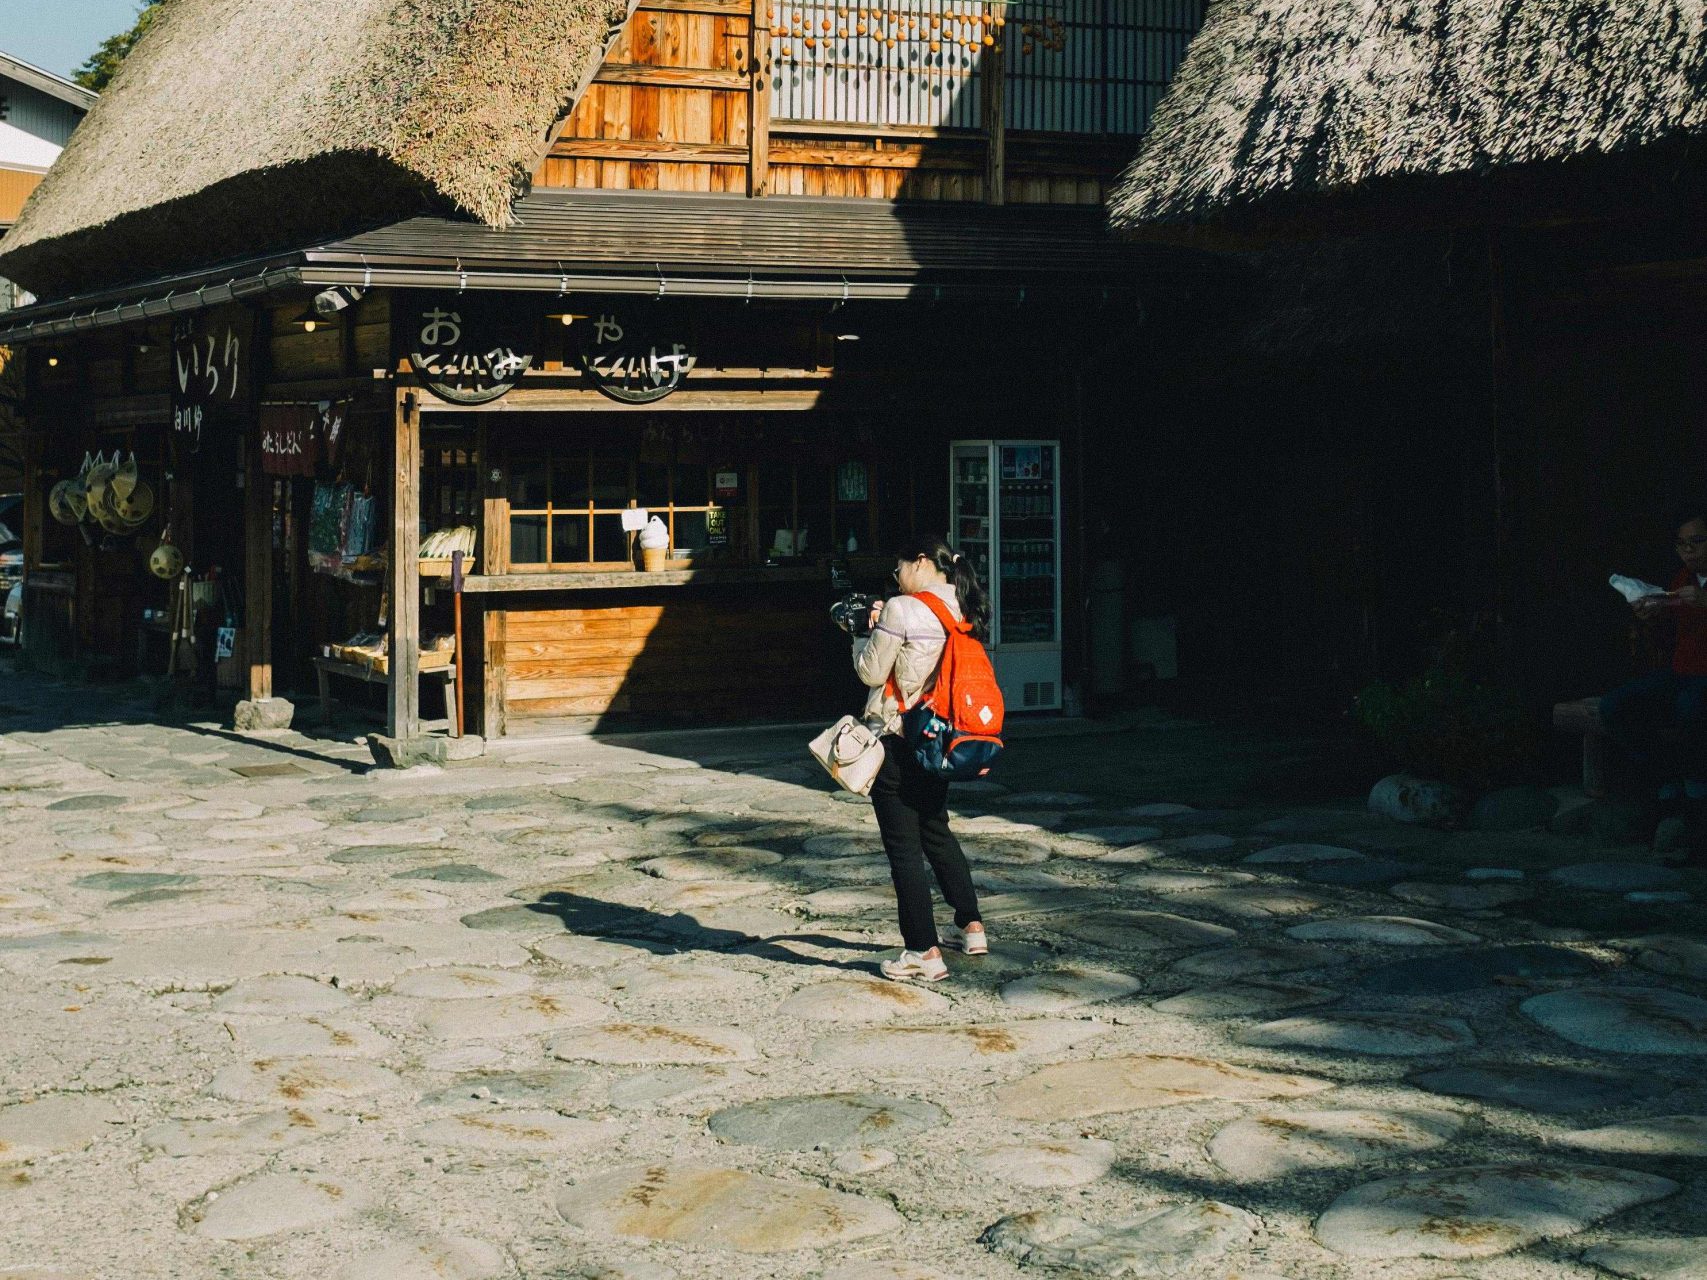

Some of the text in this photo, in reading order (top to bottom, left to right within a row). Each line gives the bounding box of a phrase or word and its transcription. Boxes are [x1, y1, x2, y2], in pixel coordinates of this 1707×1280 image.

[176, 325, 240, 400] いろり
[709, 511, 727, 519] TAKE
[710, 519, 725, 527] OUT
[709, 527, 727, 535] ONLY
